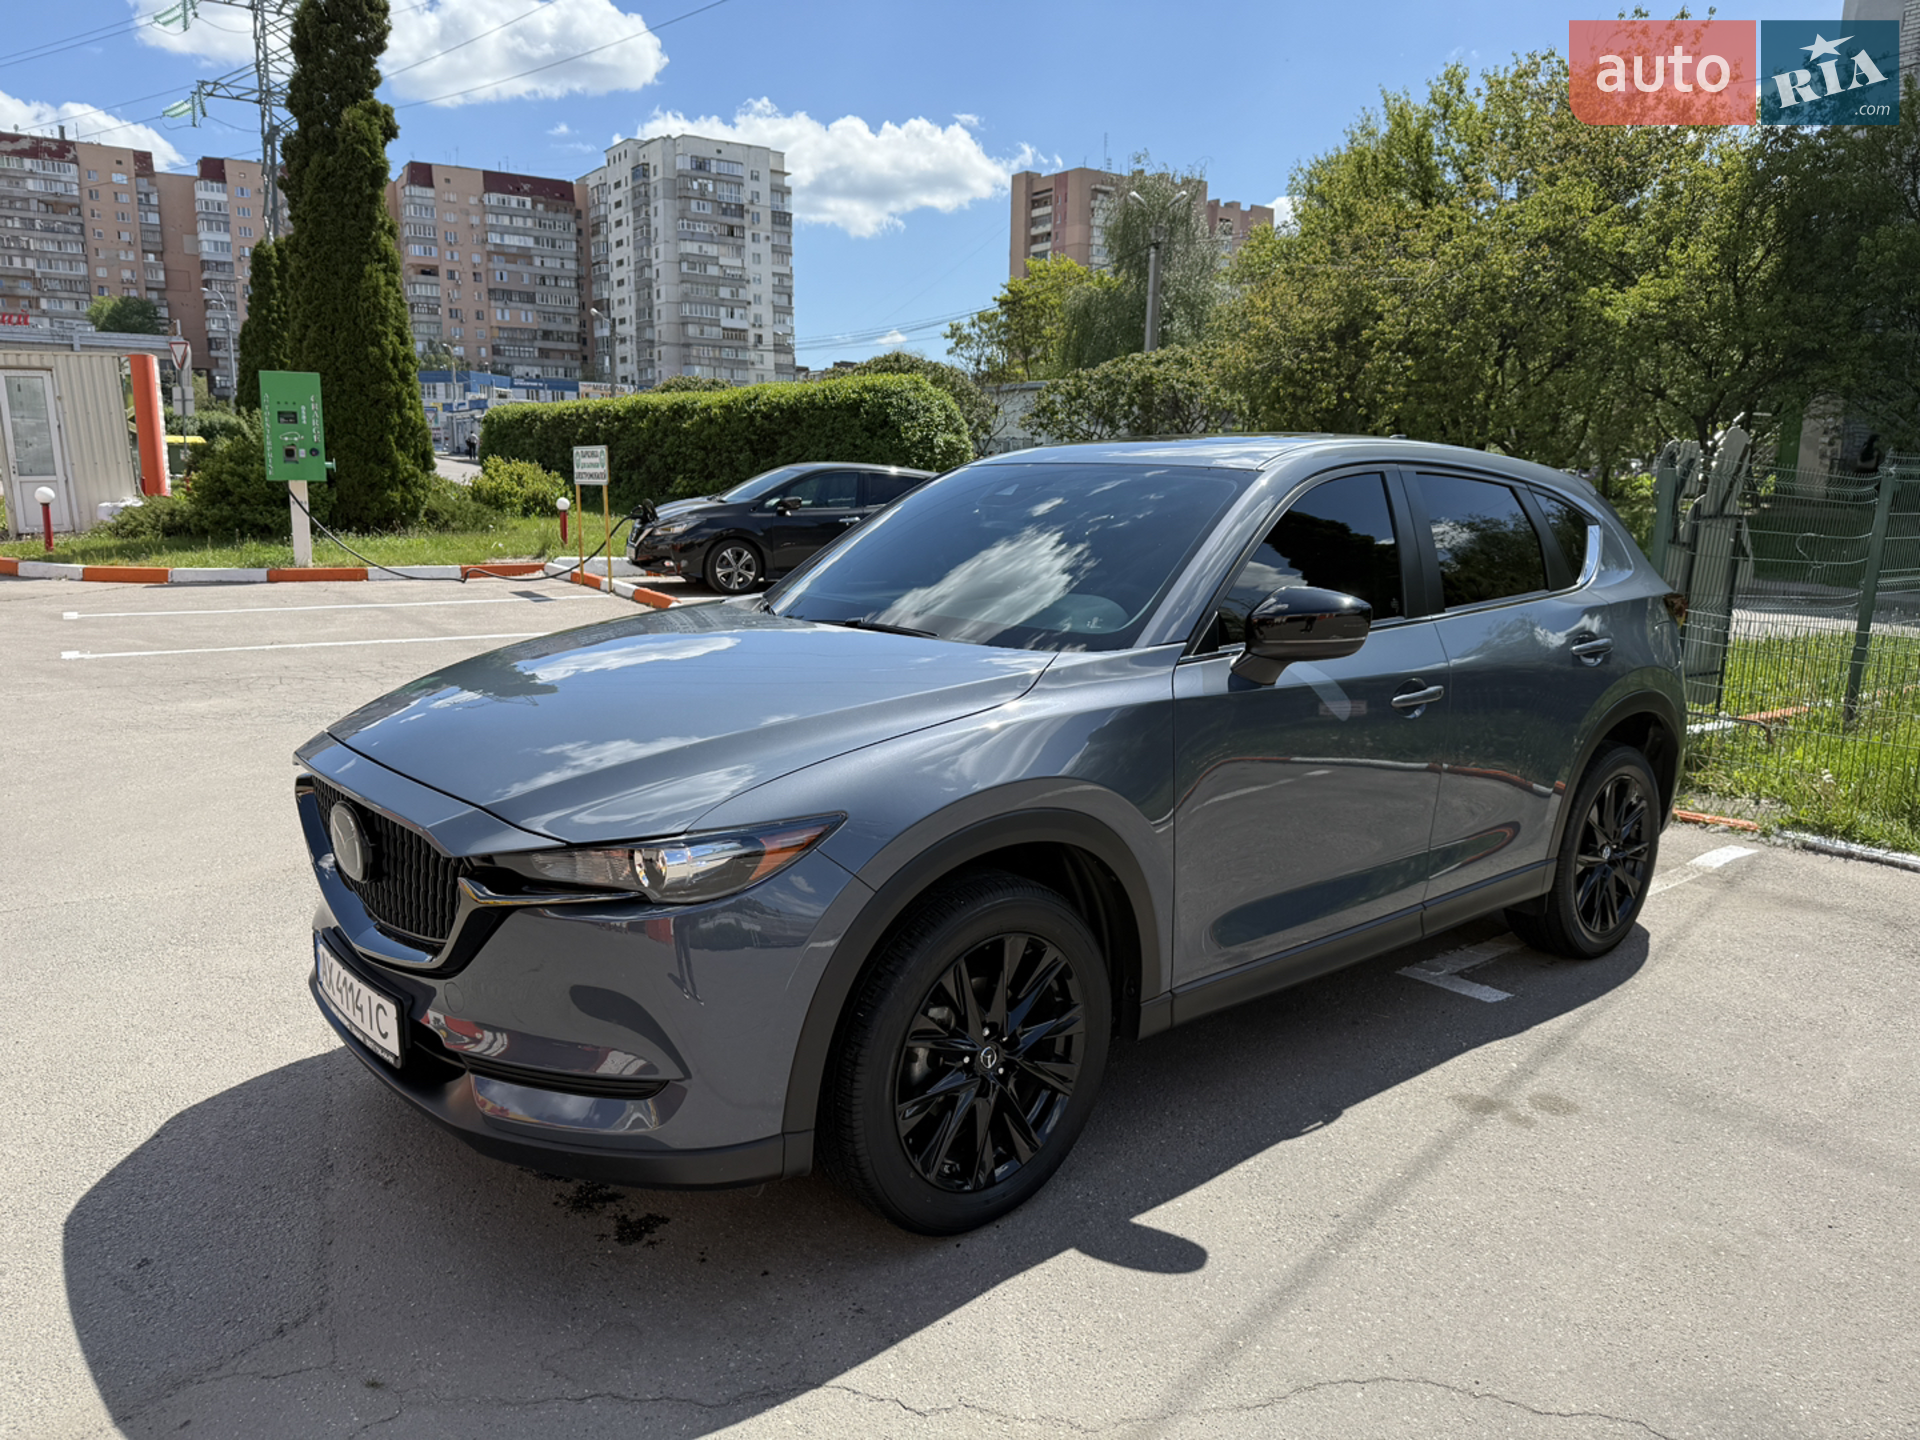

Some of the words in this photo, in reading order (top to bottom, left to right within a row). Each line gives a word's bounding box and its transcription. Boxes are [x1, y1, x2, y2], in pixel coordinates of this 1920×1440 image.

[310, 395, 320, 442] CHARGE
[335, 970, 364, 1025] 4114
[368, 995, 388, 1039] IC
